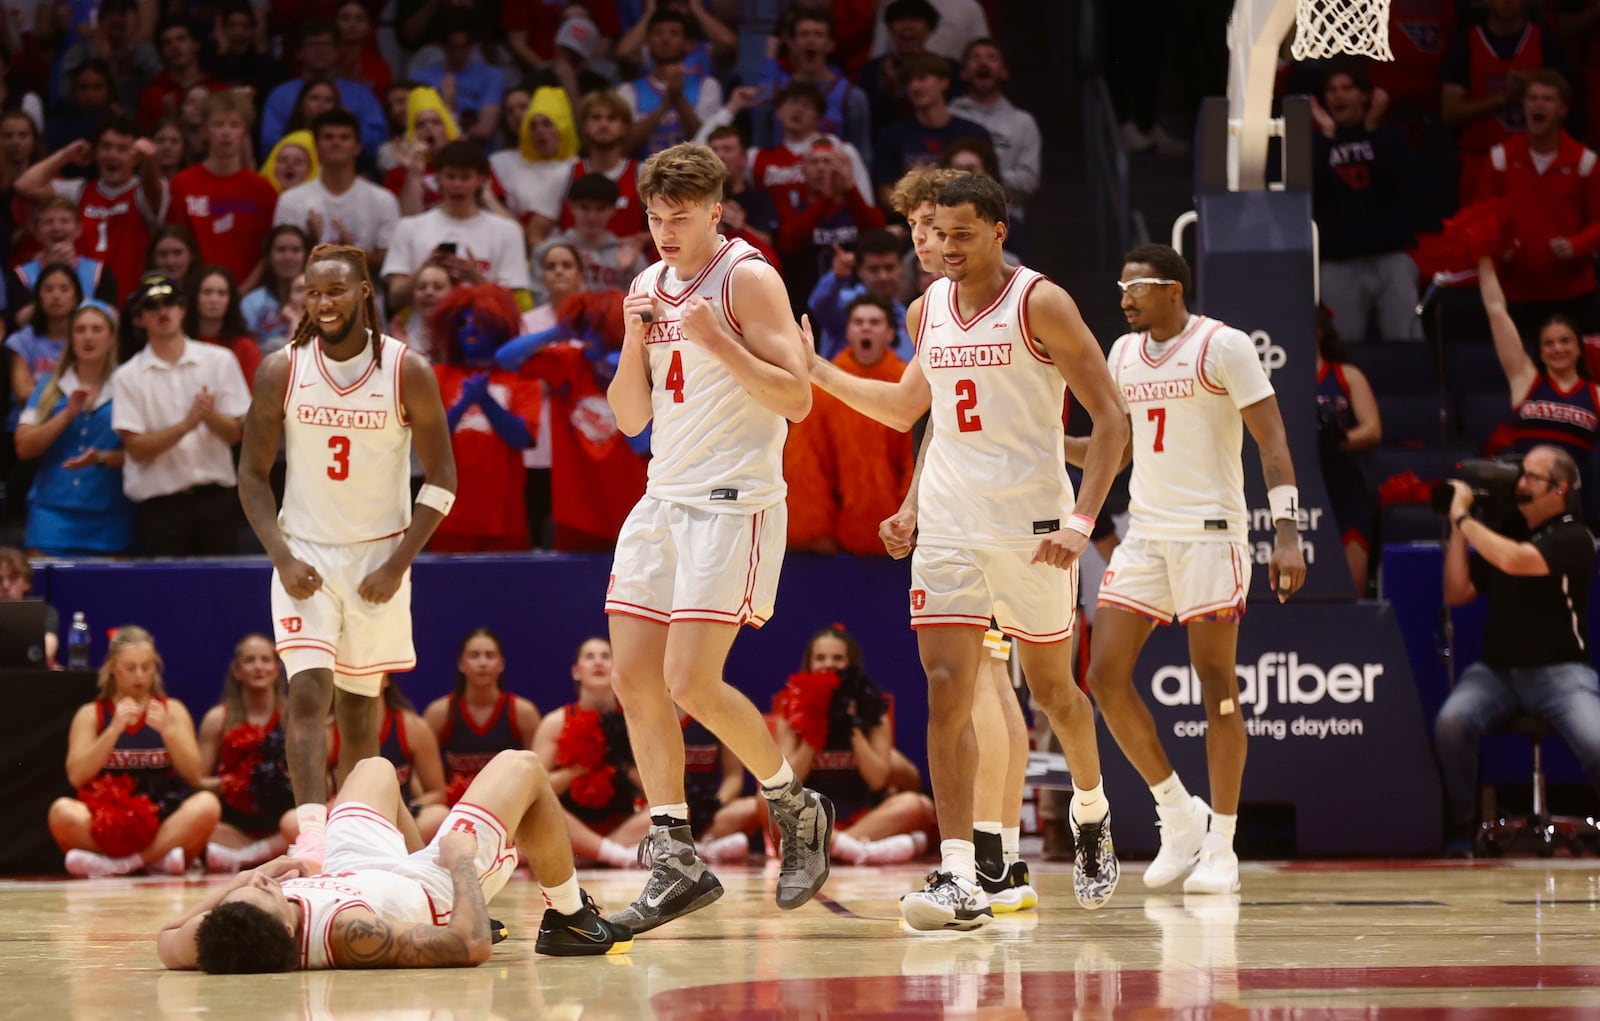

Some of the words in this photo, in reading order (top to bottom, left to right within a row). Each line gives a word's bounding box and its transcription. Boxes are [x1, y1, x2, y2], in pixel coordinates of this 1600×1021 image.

[95, 220, 109, 252] 1
[929, 343, 1012, 369] DAYTON
[665, 350, 684, 403] 4
[1123, 378, 1194, 403] DAYTON
[297, 404, 387, 430] DAYTON
[956, 379, 982, 432] 2
[1521, 400, 1597, 431] DAYTON
[1147, 408, 1166, 452] 7
[327, 436, 351, 480] 3
[1290, 716, 1363, 740] dayton
